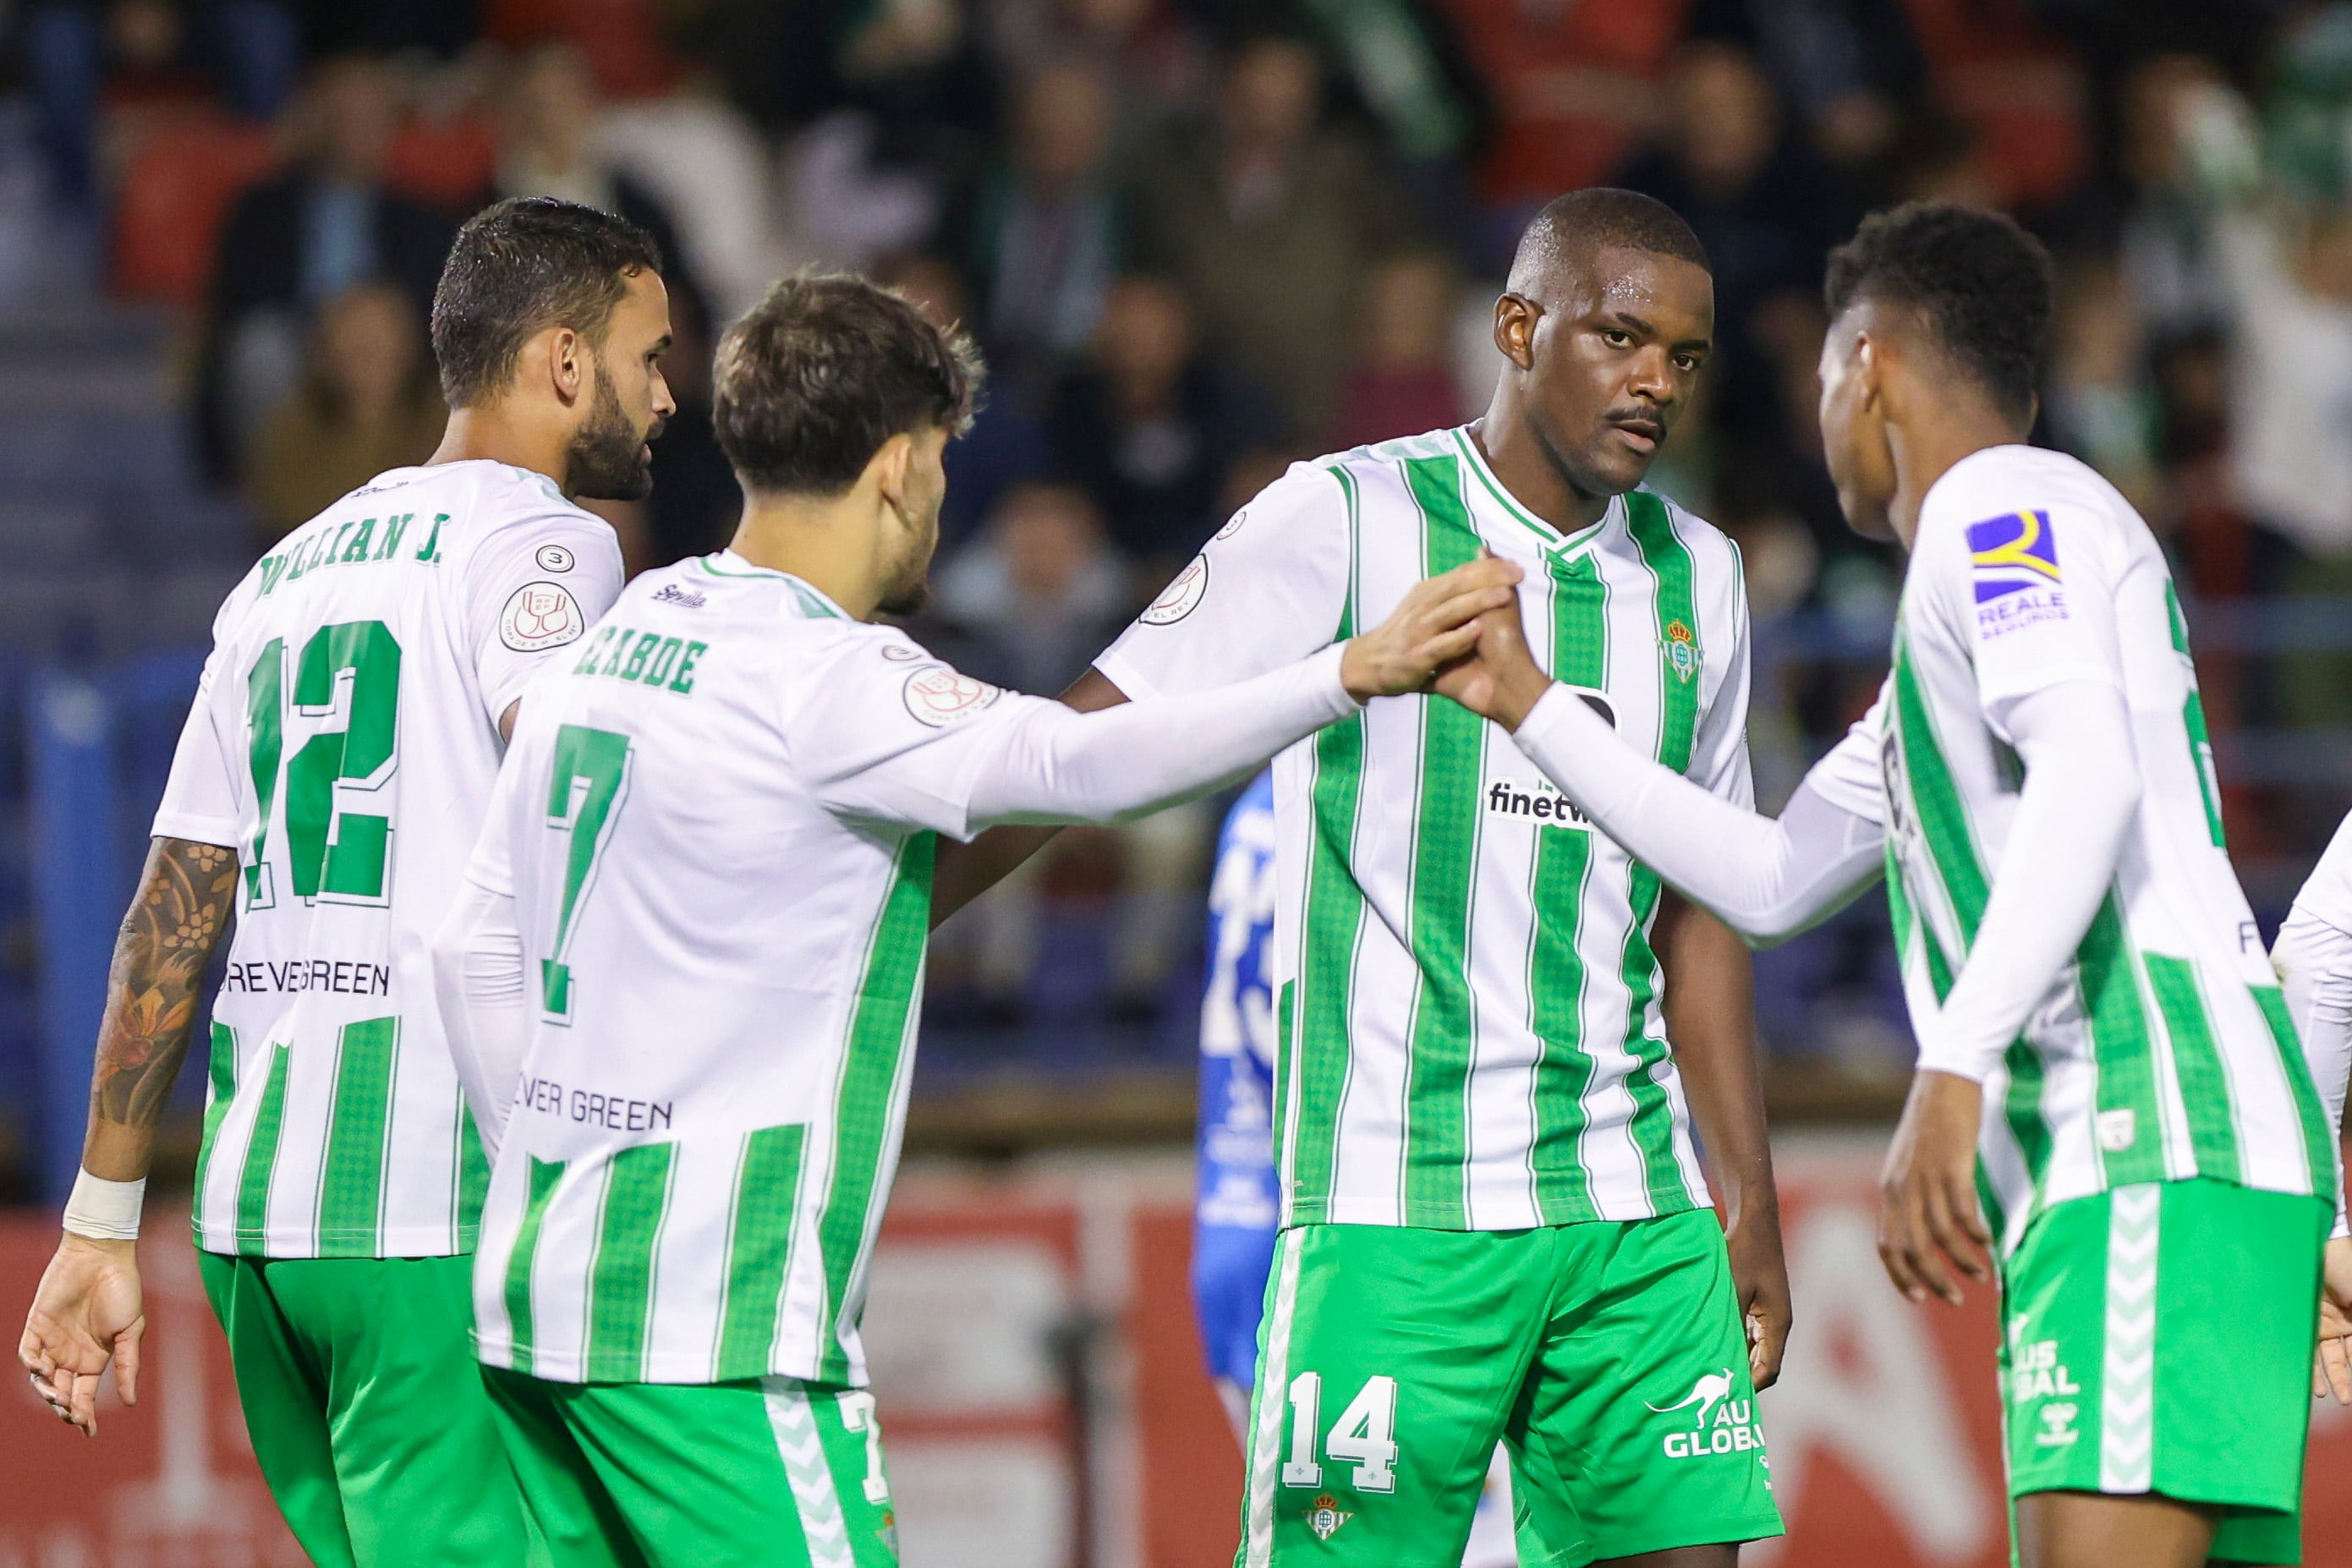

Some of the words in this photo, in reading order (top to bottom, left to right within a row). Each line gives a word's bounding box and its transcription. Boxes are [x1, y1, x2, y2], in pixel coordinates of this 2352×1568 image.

[414, 513, 451, 564] J.
[547, 551, 562, 564] 3
[1978, 592, 2066, 625] REALE
[244, 620, 403, 912] 12
[1489, 781, 1591, 824] finetw
[542, 723, 635, 1027] 7
[571, 1090, 672, 1131] GREEN
[1281, 1370, 1399, 1494] 14
[1713, 1400, 1751, 1428] AU
[834, 1391, 890, 1505] 7
